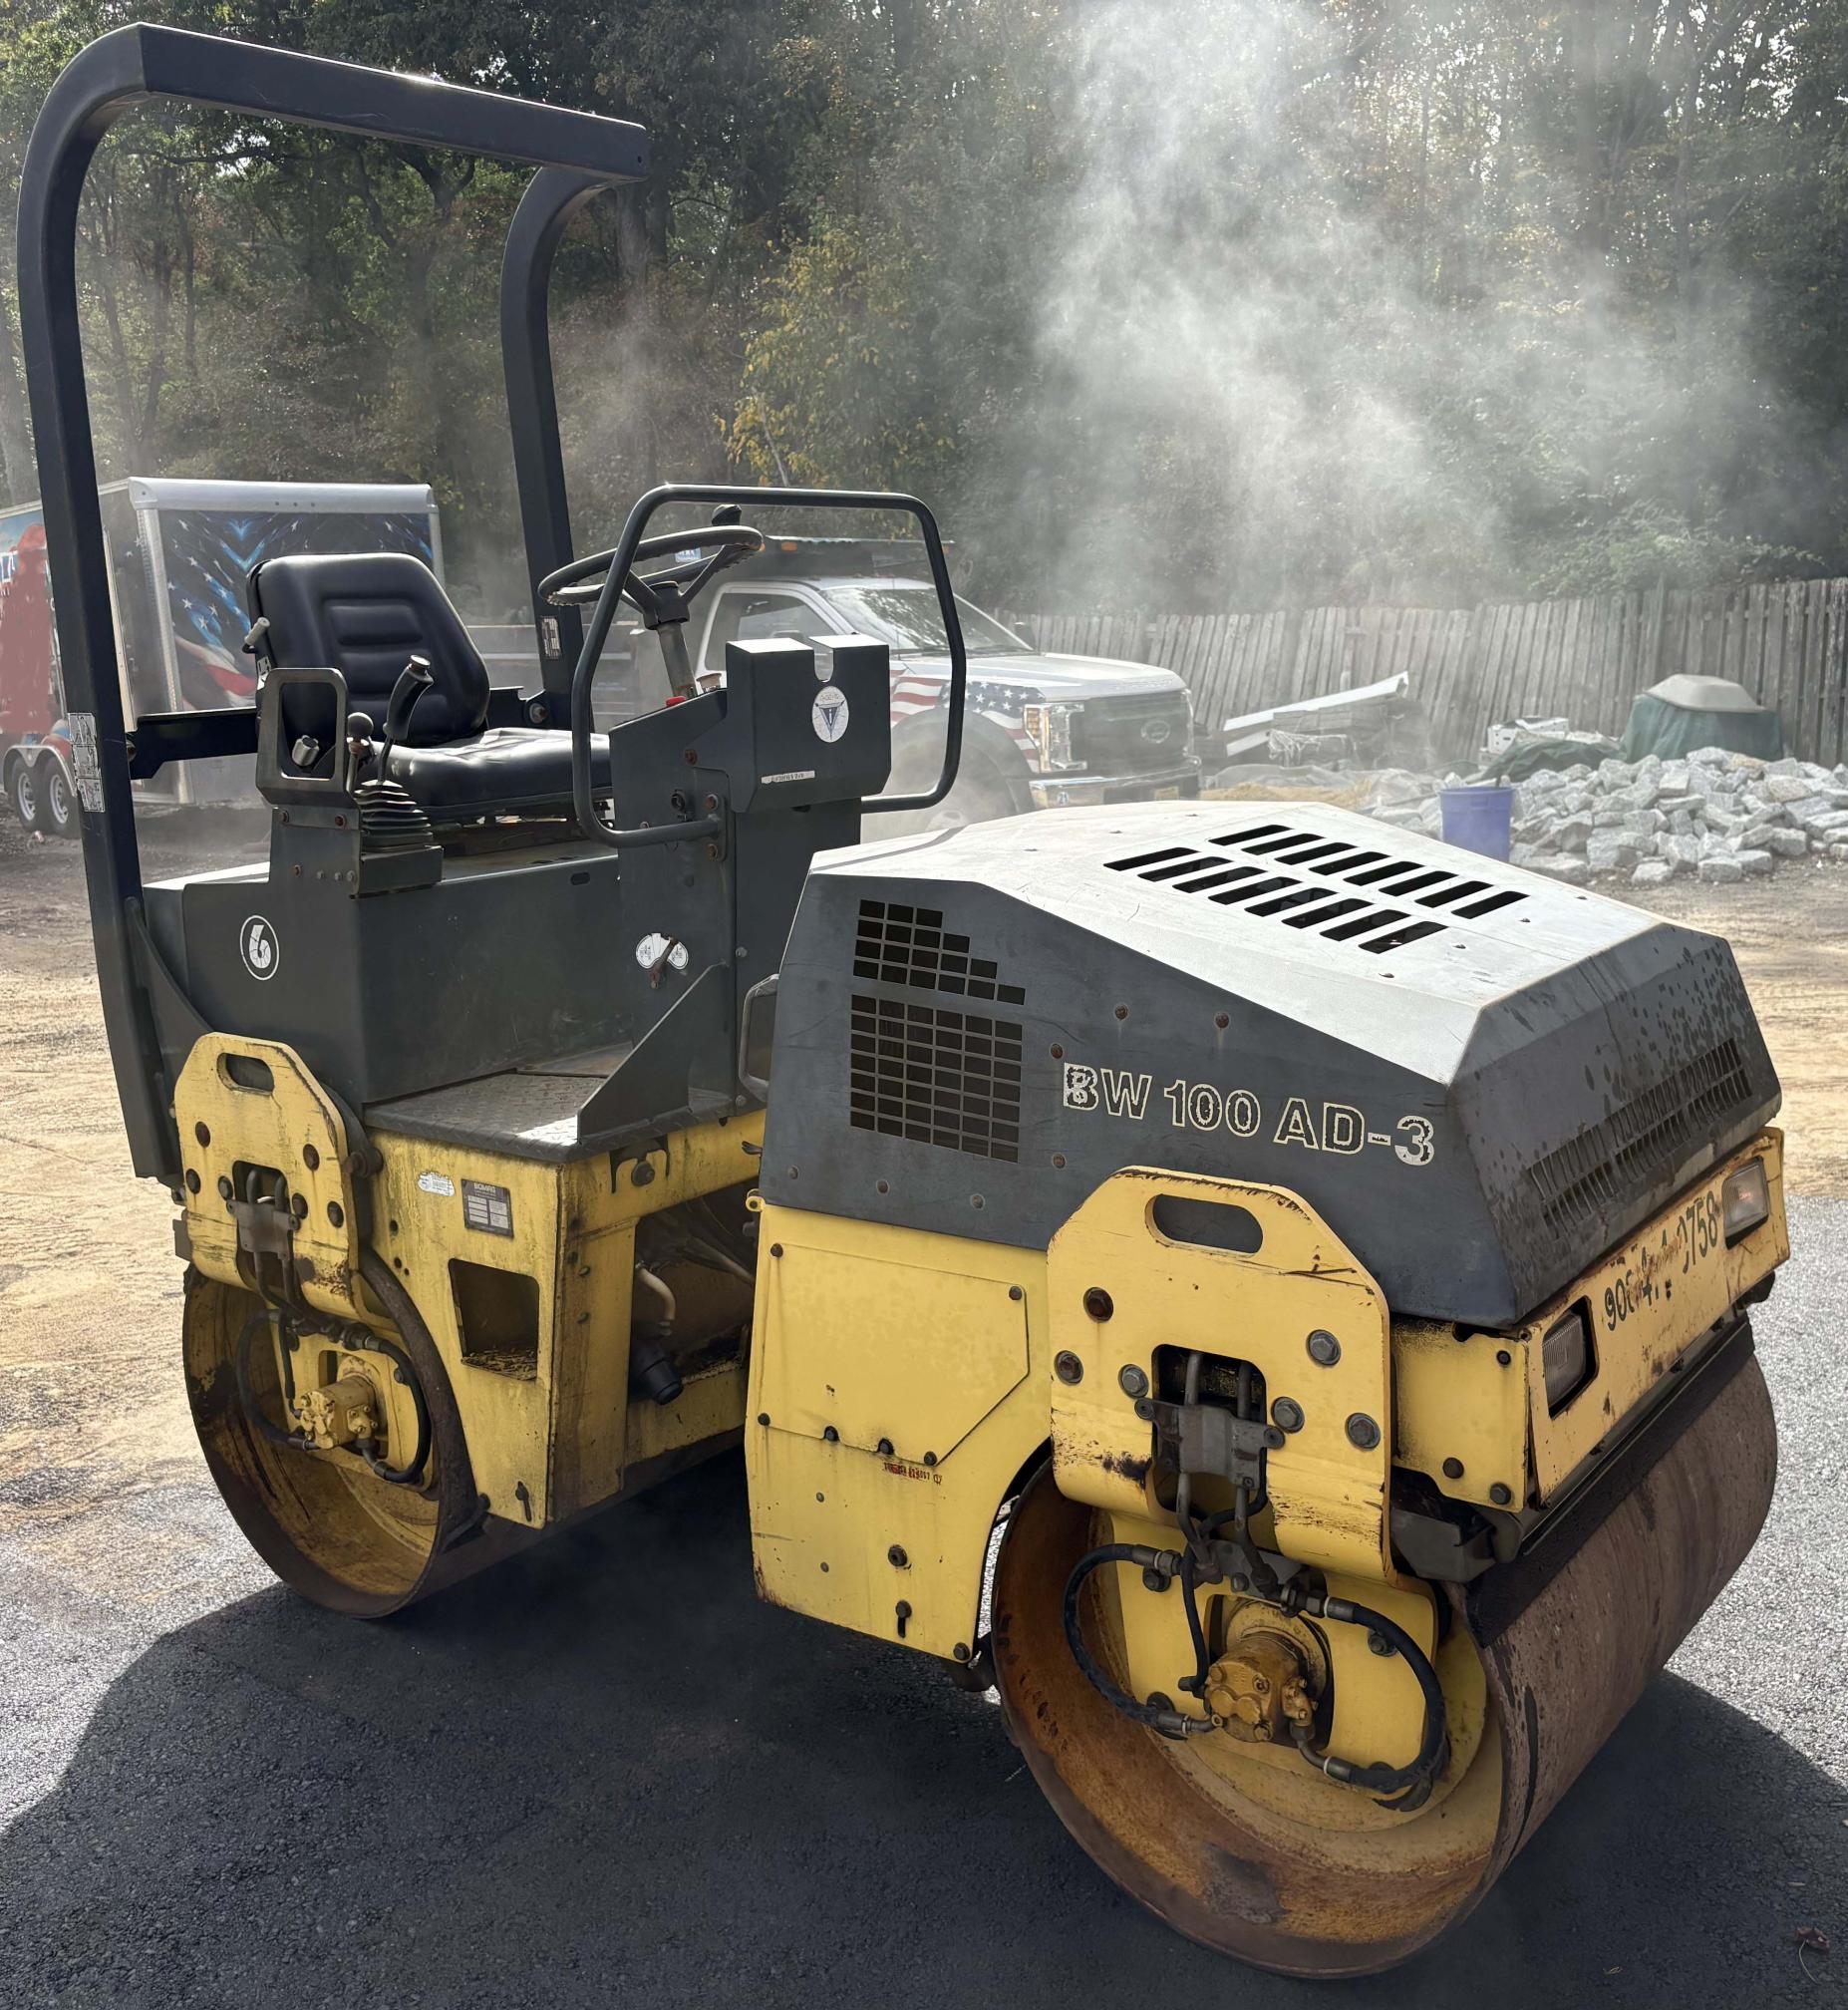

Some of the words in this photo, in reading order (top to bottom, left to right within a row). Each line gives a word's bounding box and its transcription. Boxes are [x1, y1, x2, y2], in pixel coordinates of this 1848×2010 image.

[1063, 1062, 1152, 1120] BW
[1163, 1080, 1261, 1138] 100
[1273, 1098, 1435, 1167] AD-3
